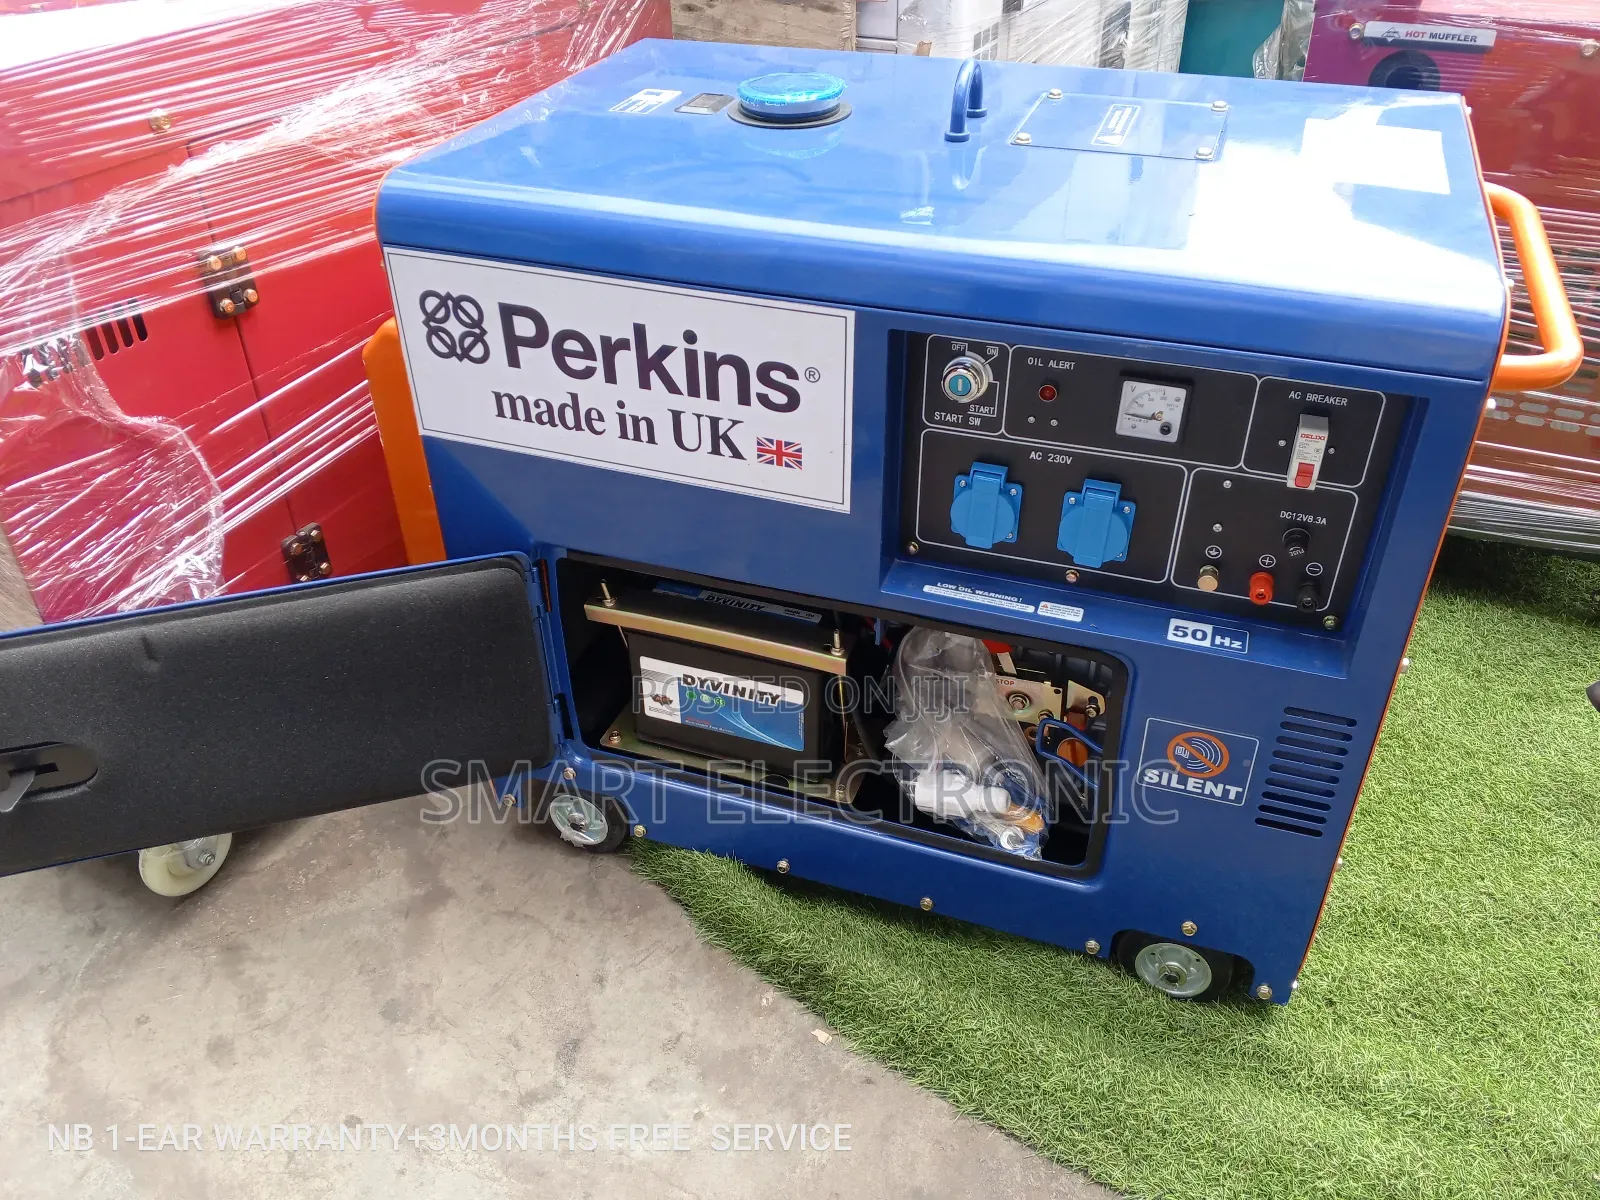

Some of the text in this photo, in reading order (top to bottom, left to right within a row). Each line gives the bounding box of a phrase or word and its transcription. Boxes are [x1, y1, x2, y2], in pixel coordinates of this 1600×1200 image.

[1405, 30, 1427, 39] HOT
[1429, 32, 1478, 43] MUFFLER
[951, 343, 966, 352] OFF
[986, 347, 997, 356] ON
[1027, 356, 1076, 371] OIL ALERT
[1288, 390, 1348, 406] AC BREAKER
[969, 405, 995, 415] START
[492, 390, 747, 461] made in UK
[934, 411, 982, 427] START SW
[1029, 450, 1073, 465] AC 230V
[1280, 510, 1327, 525] DC12V8.3A
[937, 582, 957, 592] LOW
[704, 594, 767, 612] DYVINITY
[1171, 625, 1243, 649] 50 Hz
[681, 673, 783, 707] DYVINITY
[1143, 769, 1243, 800] SILENT
